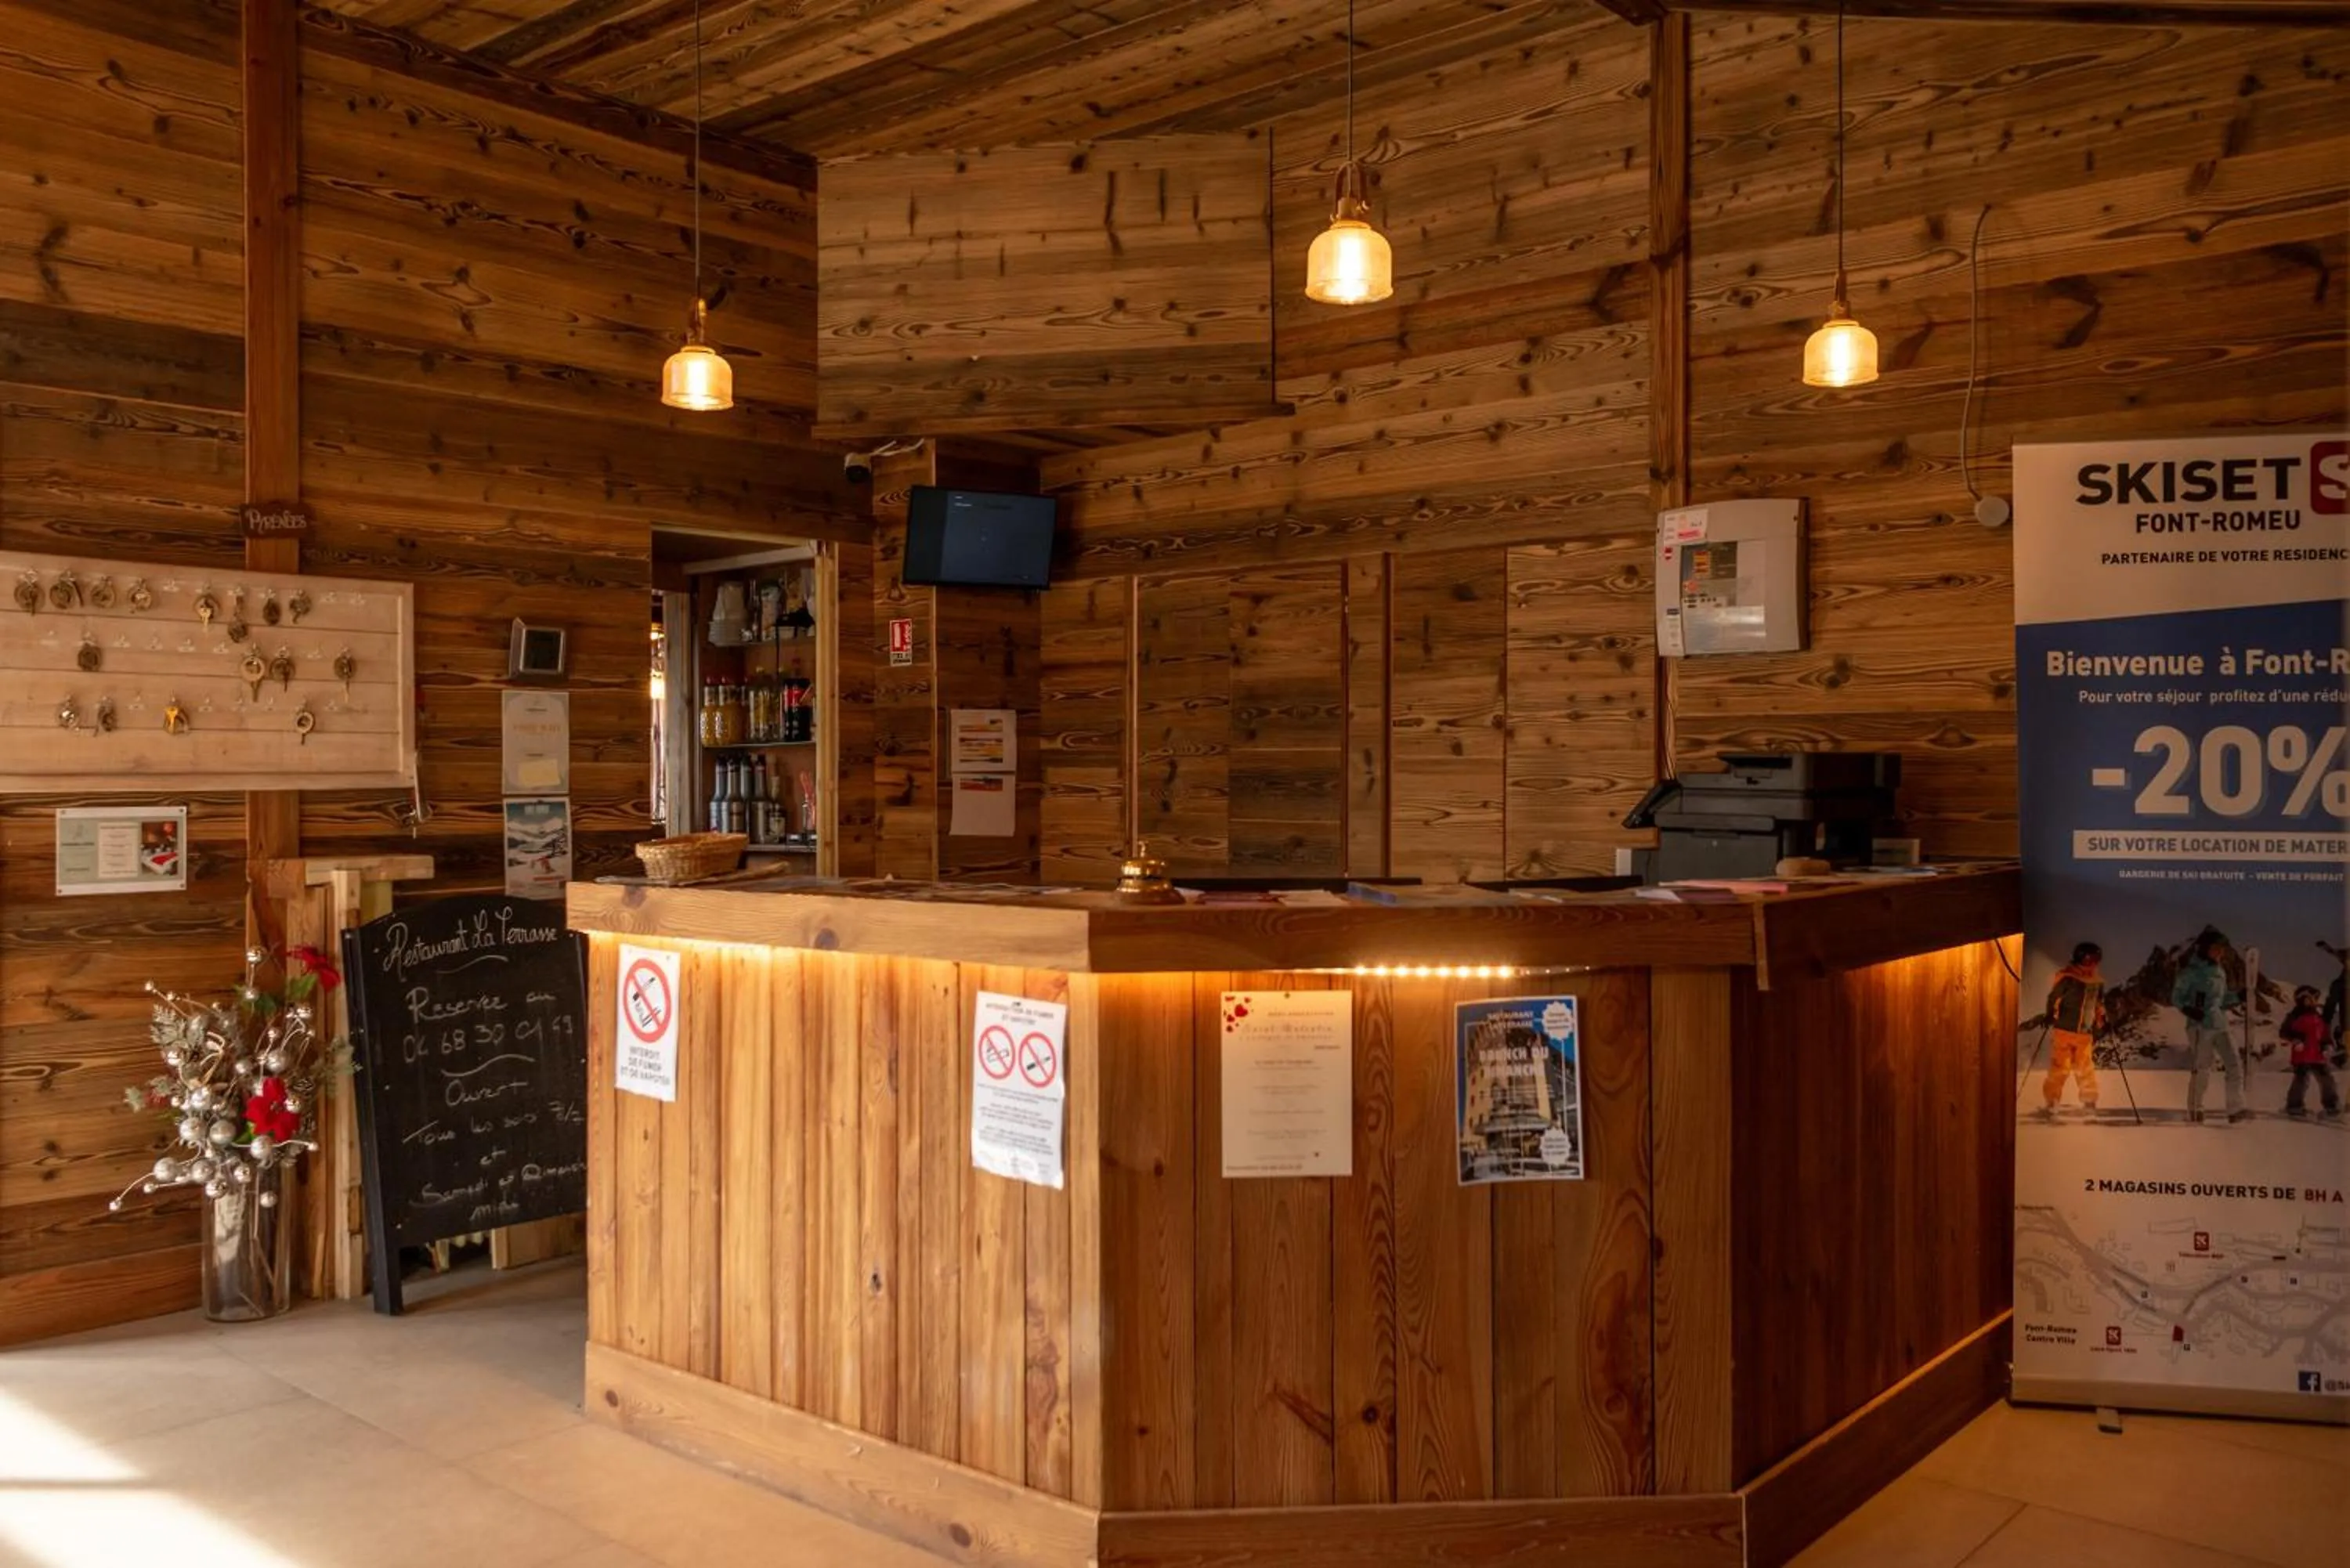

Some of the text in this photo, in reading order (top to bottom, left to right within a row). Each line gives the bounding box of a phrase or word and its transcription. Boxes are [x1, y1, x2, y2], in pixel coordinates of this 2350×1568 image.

[2076, 457, 2301, 505] SKISET
[2136, 510, 2300, 533] FONT-ROMEU
[2102, 551, 2193, 565] PARTENAIRE
[2198, 551, 2217, 563] DE
[2222, 550, 2269, 562] VOTRE
[2046, 650, 2204, 677] Bienvenue
[2219, 646, 2236, 676] à
[2079, 690, 2111, 703] Pour
[2116, 691, 2153, 703] votre
[2157, 689, 2202, 705] séjour
[2210, 688, 2265, 705] profitez
[2269, 689, 2310, 703] d'une
[2092, 725, 2350, 818] -20%
[2088, 837, 2120, 851] SUR
[2124, 837, 2177, 852] VOTRE
[2182, 838, 2260, 853] LOCATION
[2265, 839, 2287, 852] DE
[383, 905, 559, 982] Restaurant La Terrasse
[441, 1029, 465, 1054] 68
[2084, 1179, 2095, 1191] 2
[2099, 1180, 2186, 1195] MAGASINS
[2191, 1183, 2268, 1199] OUVERTS
[2273, 1187, 2295, 1201] DE
[2331, 1190, 2343, 1203] A
